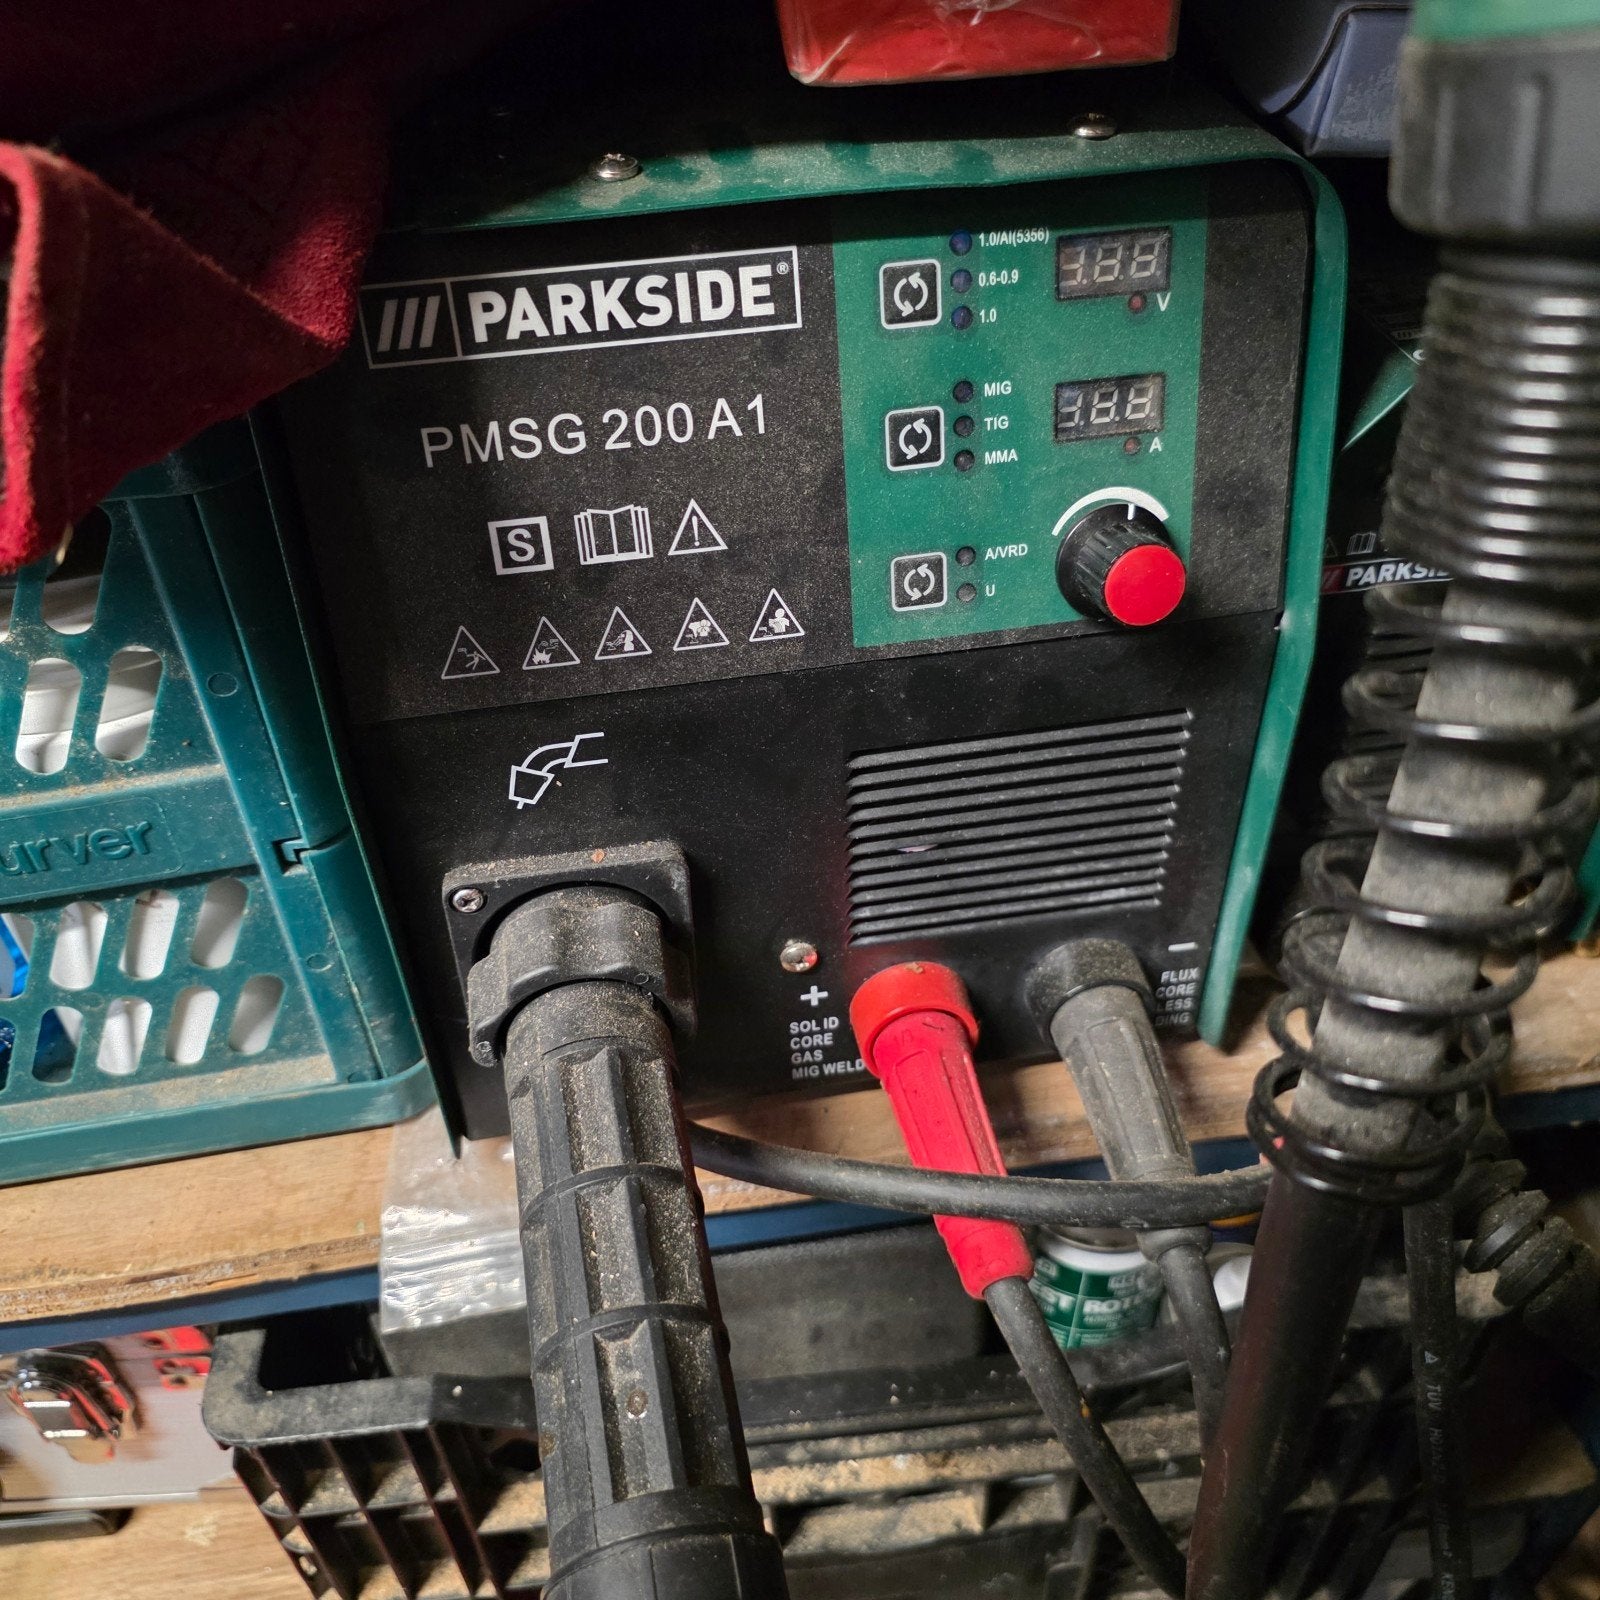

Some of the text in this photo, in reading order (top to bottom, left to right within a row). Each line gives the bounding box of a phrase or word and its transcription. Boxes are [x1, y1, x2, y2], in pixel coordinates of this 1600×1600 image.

[979, 269, 1019, 287] 0.6-0.9
[1156, 292, 1171, 311] V
[979, 308, 997, 323] 1.0
[984, 381, 1012, 397] MIG
[420, 394, 766, 468] PMSG 200 A1
[984, 415, 1009, 431] TIG
[1149, 436, 1162, 453] A
[984, 448, 1018, 465] MMA
[985, 543, 1028, 560] A/VRD
[985, 584, 995, 597] U
[1161, 967, 1200, 983] FLUX
[1156, 982, 1196, 998] CORE
[790, 1033, 834, 1050] CORE
[791, 1049, 824, 1064] GAS
[792, 1065, 820, 1080] MIG
